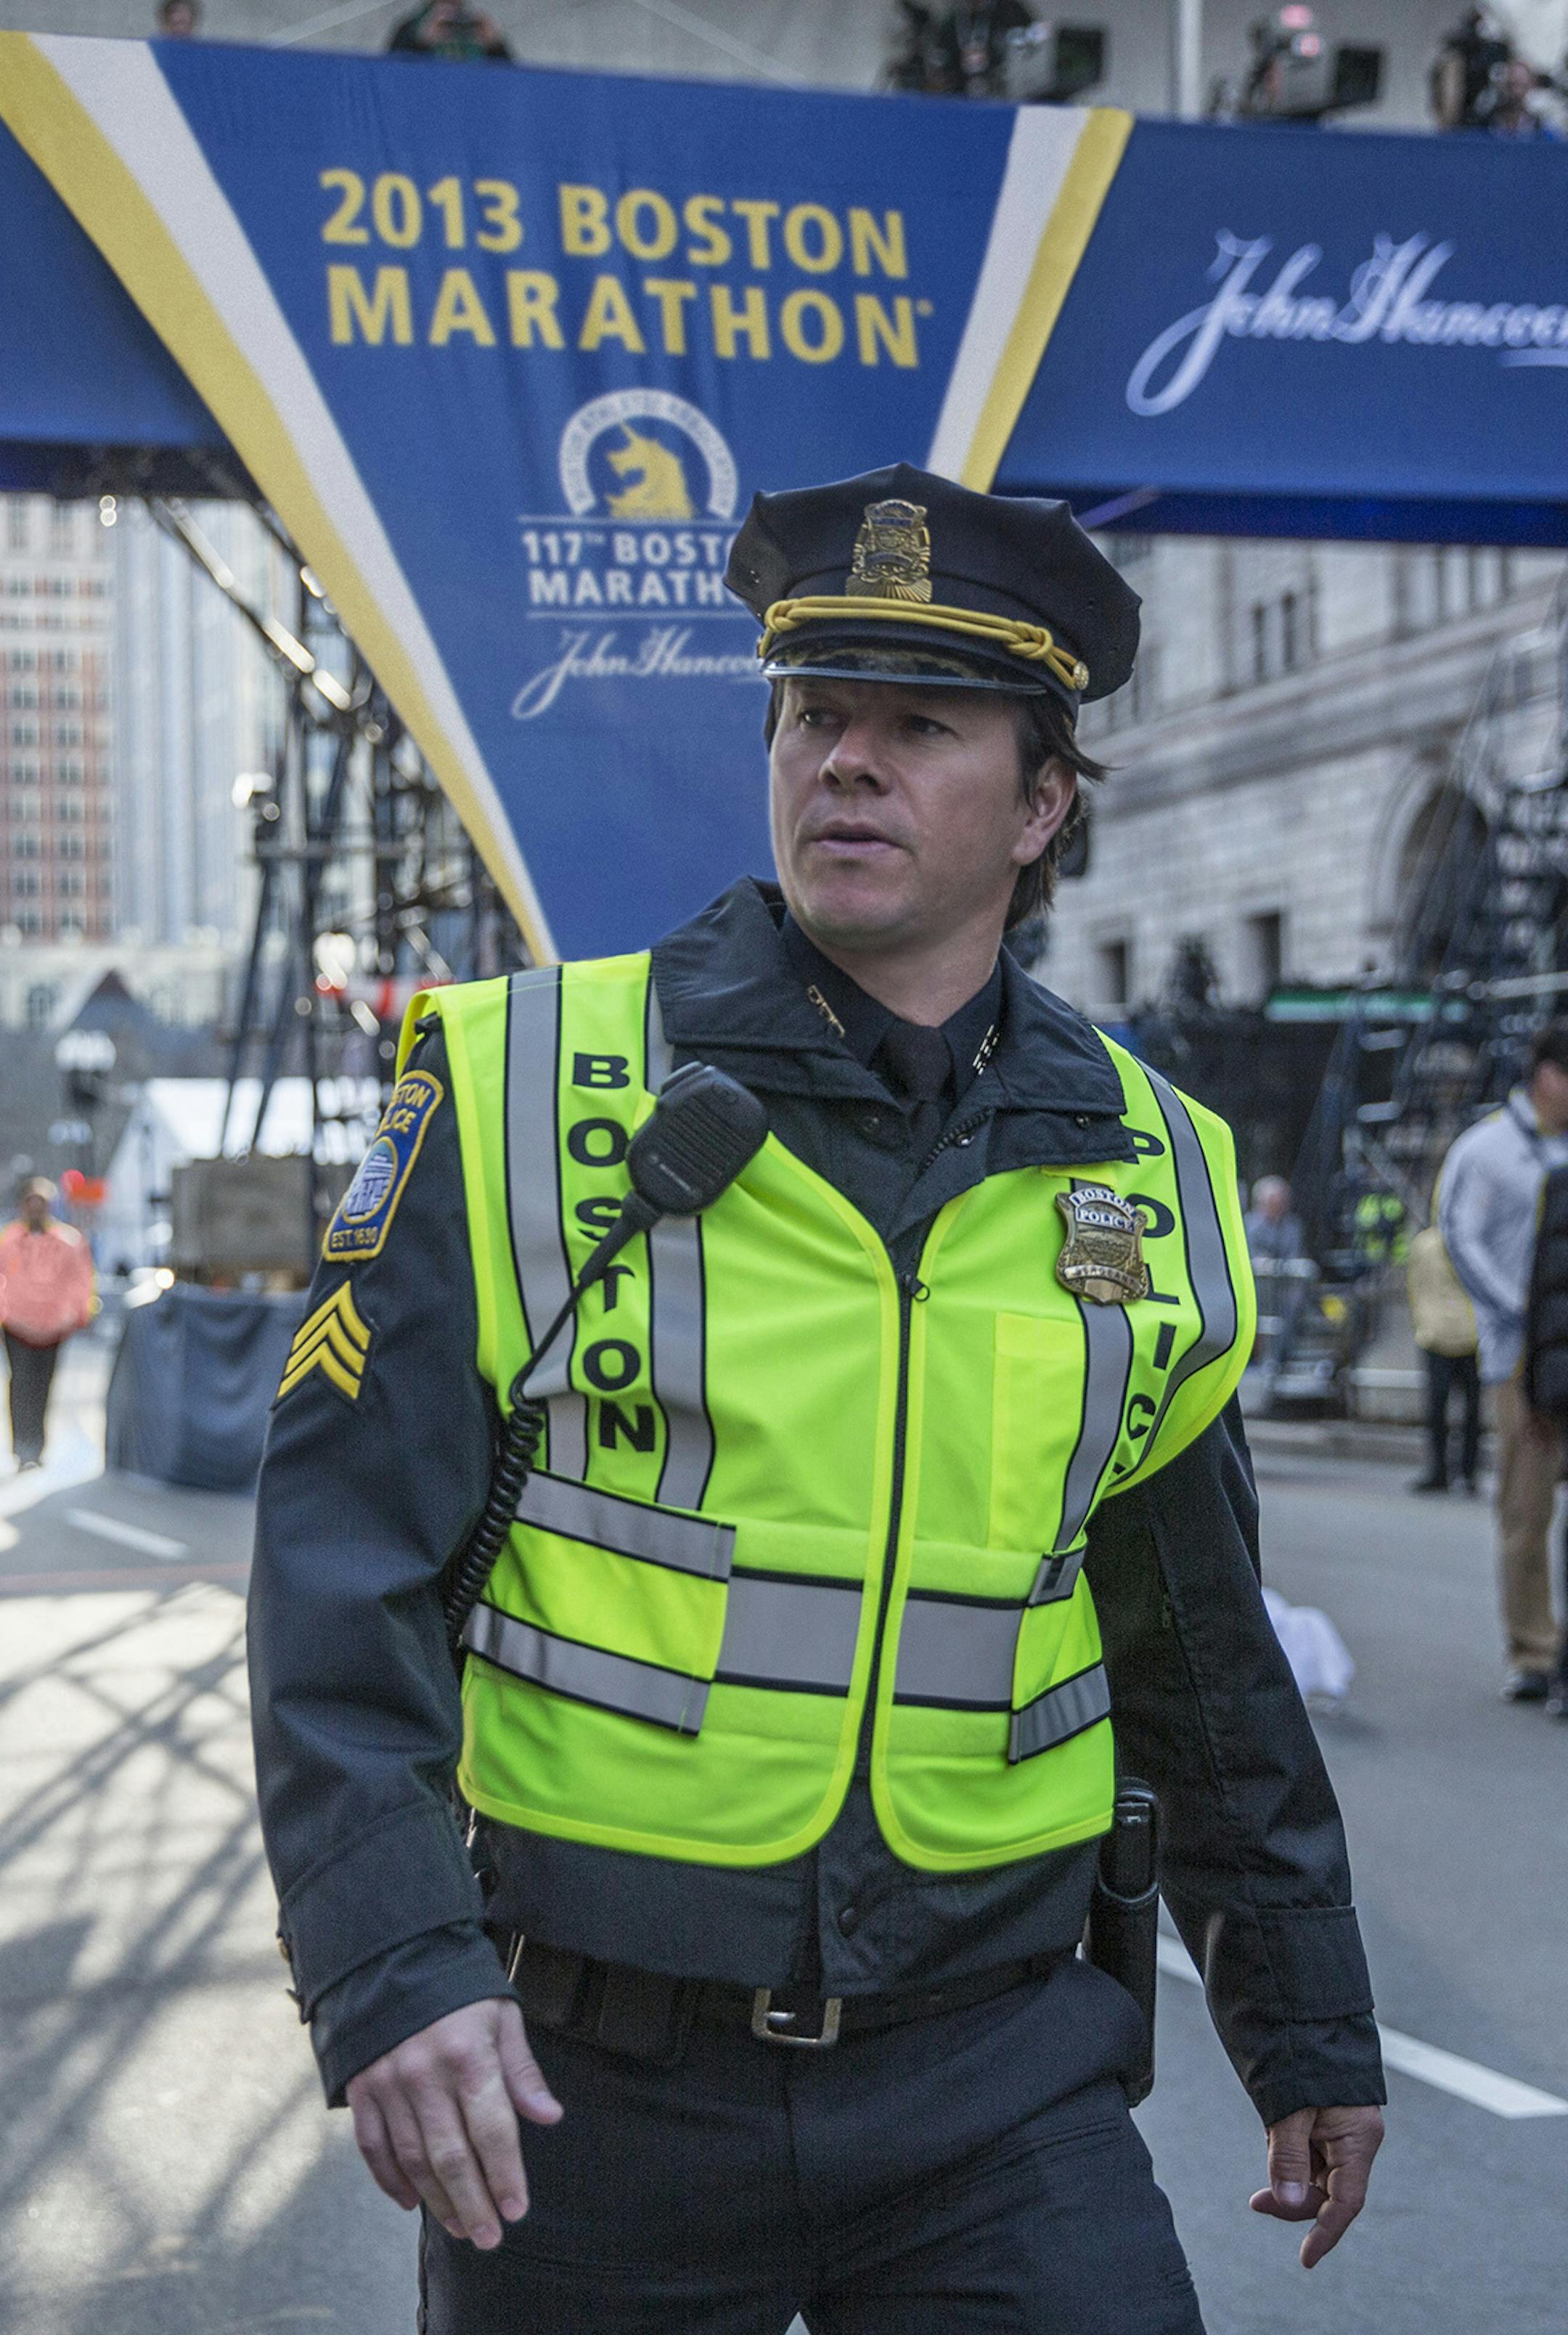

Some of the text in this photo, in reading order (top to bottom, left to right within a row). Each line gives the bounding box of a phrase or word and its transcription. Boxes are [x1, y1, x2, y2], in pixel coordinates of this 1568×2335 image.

[320, 168, 908, 279] 2013 BOSTON
[326, 265, 920, 368] MARATHON
[1126, 228, 1336, 416] John
[528, 569, 742, 606] MARATH
[612, 531, 735, 566] BOST
[512, 629, 629, 720] John
[567, 1052, 655, 1453] BOSTON
